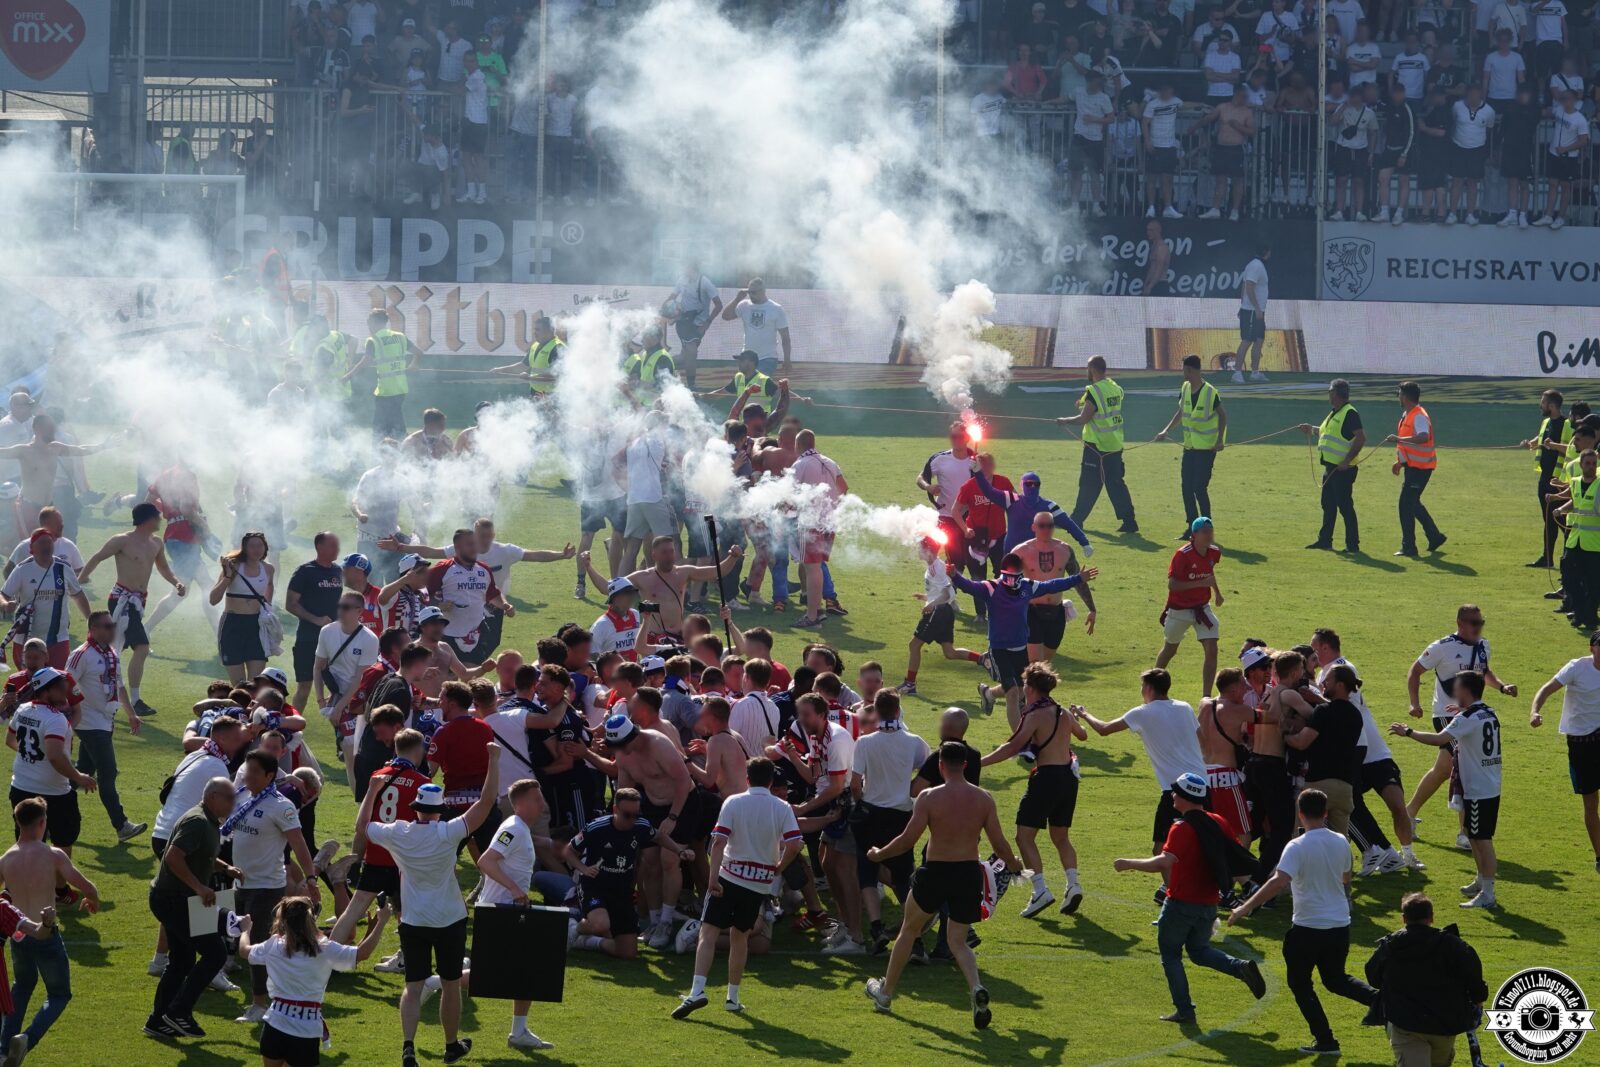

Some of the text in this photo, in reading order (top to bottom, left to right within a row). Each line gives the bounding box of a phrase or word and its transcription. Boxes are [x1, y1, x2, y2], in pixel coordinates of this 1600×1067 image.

[1101, 234, 1193, 267] Regon
[1387, 258, 1542, 281] REICHSRAT
[378, 785, 399, 823] 8
